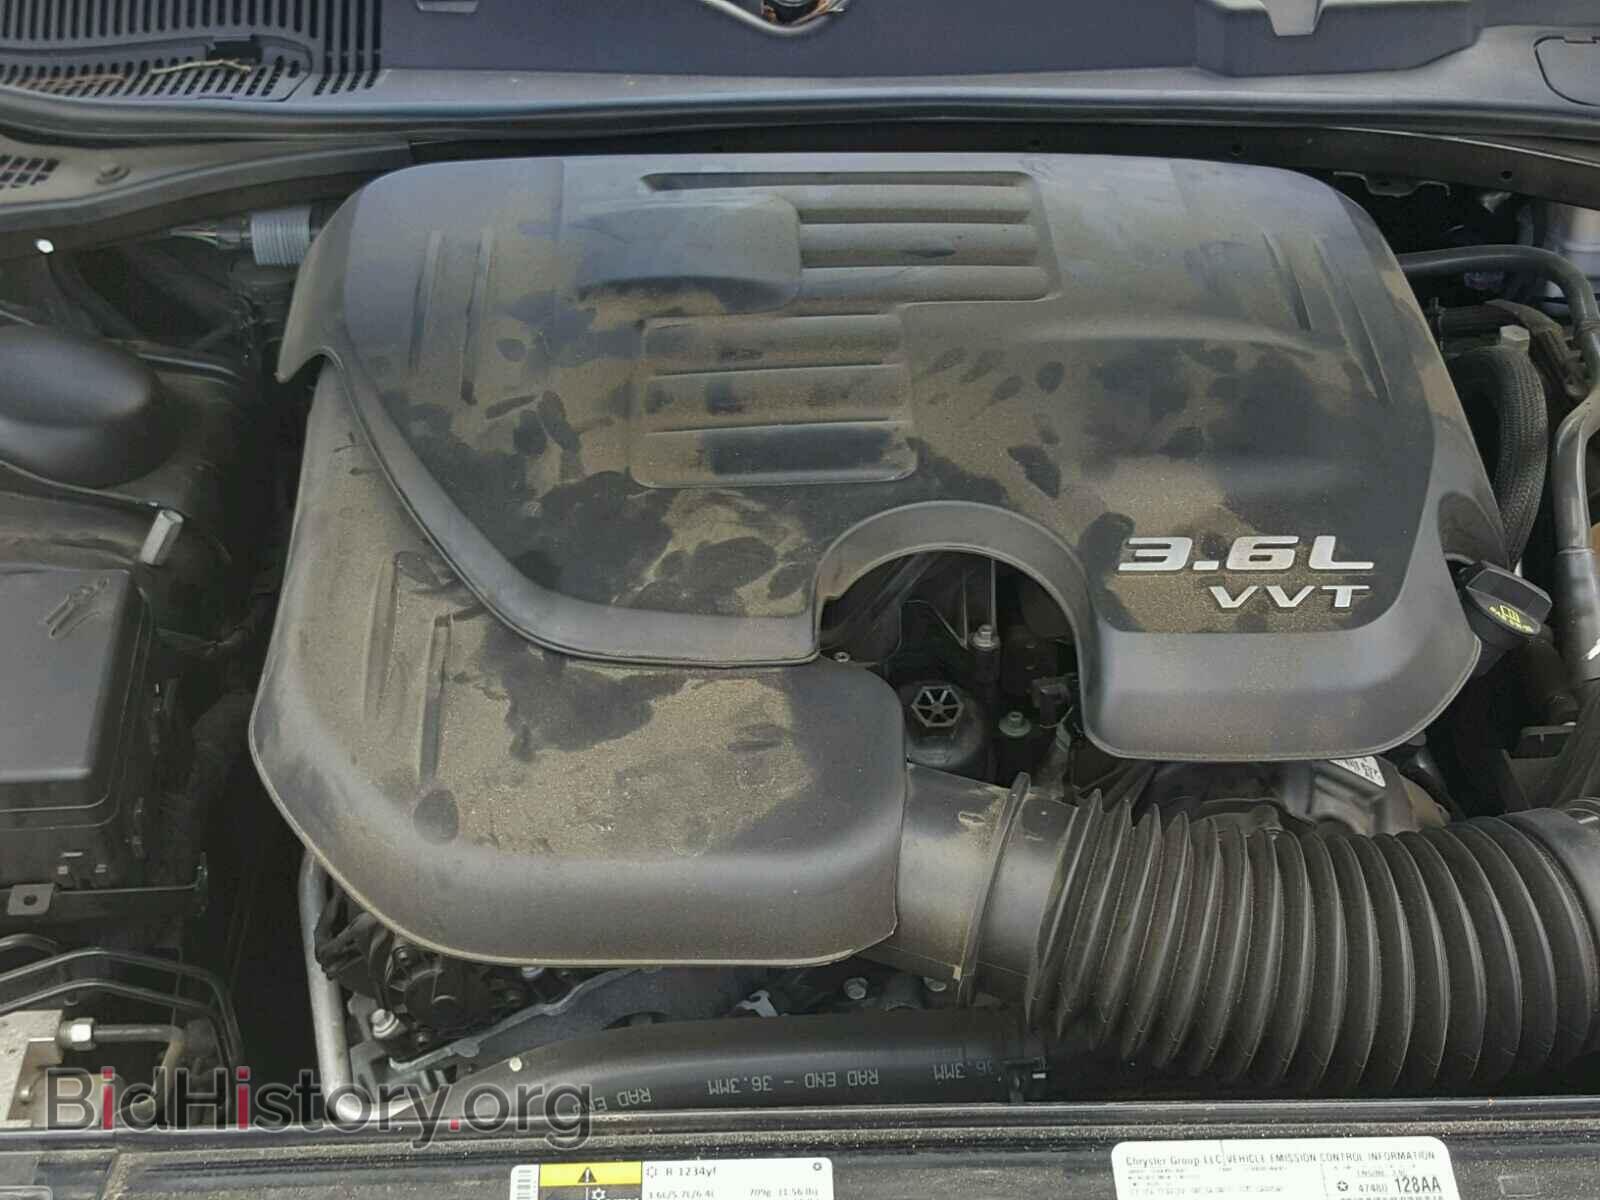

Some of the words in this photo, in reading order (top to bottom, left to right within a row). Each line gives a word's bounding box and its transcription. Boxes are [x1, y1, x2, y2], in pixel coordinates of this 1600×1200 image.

[1117, 535, 1375, 572] 3.6L
[1209, 585, 1371, 608] VVT
[707, 1074, 773, 1095] 36.3MM
[805, 1070, 837, 1089] END
[847, 1068, 880, 1086] RAD
[617, 1087, 652, 1107] RAD
[1170, 1155, 1200, 1167] Group
[1227, 1154, 1266, 1164] VEHICLE
[1270, 1153, 1317, 1163] EMISSION
[1320, 1152, 1364, 1162] CONTROL
[1368, 1151, 1436, 1161] INFORMATION
[1395, 1176, 1442, 1193] 128AA
